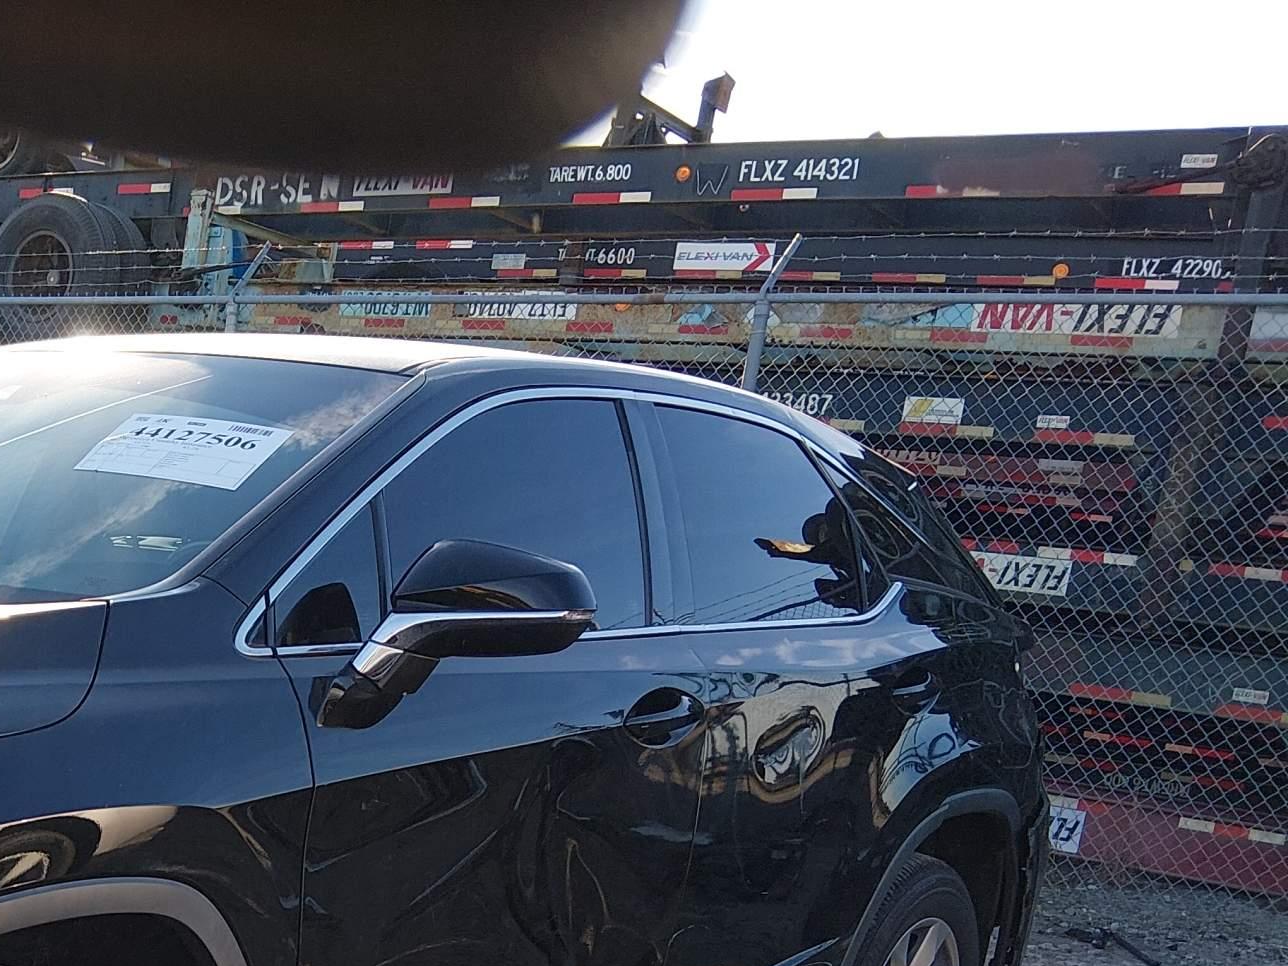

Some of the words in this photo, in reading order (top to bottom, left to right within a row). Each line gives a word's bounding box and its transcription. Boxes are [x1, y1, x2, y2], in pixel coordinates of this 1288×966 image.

[738, 159, 787, 182] FLXZ
[792, 157, 860, 181] 414321
[131, 425, 261, 450] 44127506
